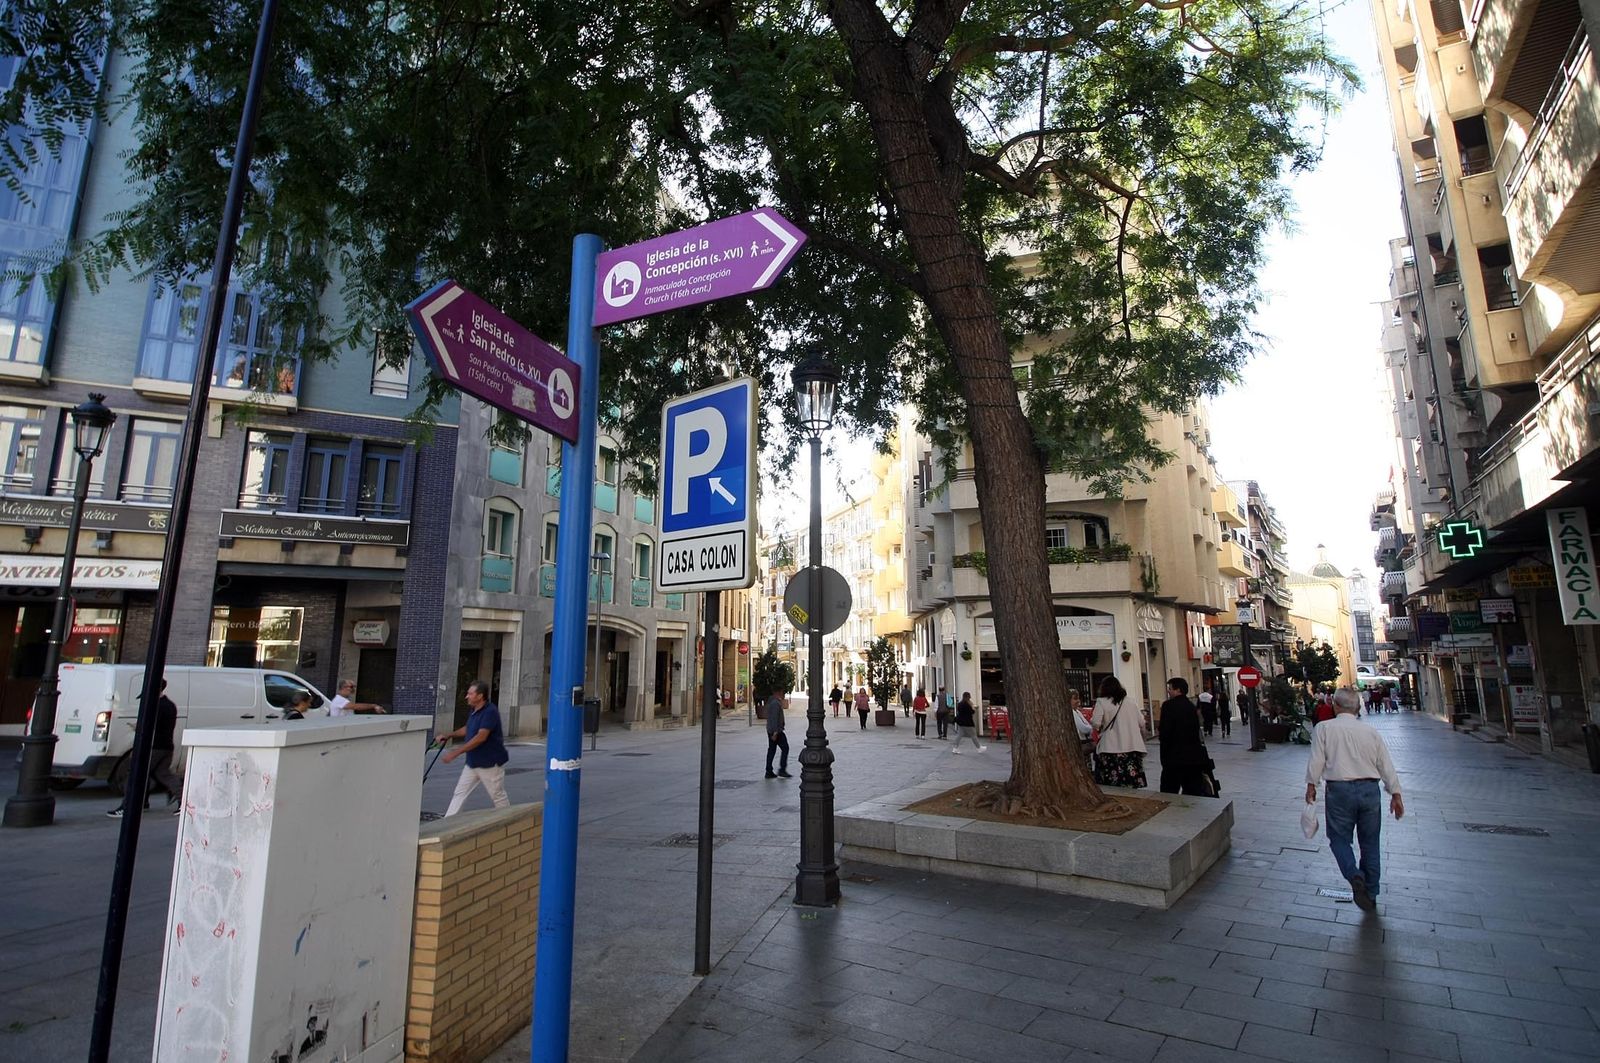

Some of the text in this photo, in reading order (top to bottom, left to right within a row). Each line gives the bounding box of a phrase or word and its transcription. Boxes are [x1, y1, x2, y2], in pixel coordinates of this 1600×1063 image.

[646, 238, 709, 266] Iglesia de la
[646, 246, 744, 279] Concepción (s. XVI)
[644, 268, 731, 295] Inmaculada Concepción
[644, 283, 712, 306] Church (16th cent.)
[471, 309, 516, 348] Iglesia de
[469, 330, 541, 383] San Pedro (s. XV)
[469, 353, 524, 387] San Pedro Church
[468, 366, 504, 394] (15th cent.)
[671, 406, 728, 516] P
[235, 524, 278, 535] Medicina
[280, 526, 315, 538] Estética
[667, 544, 737, 574] CASA COLON
[1558, 511, 1598, 620] FARMACIA
